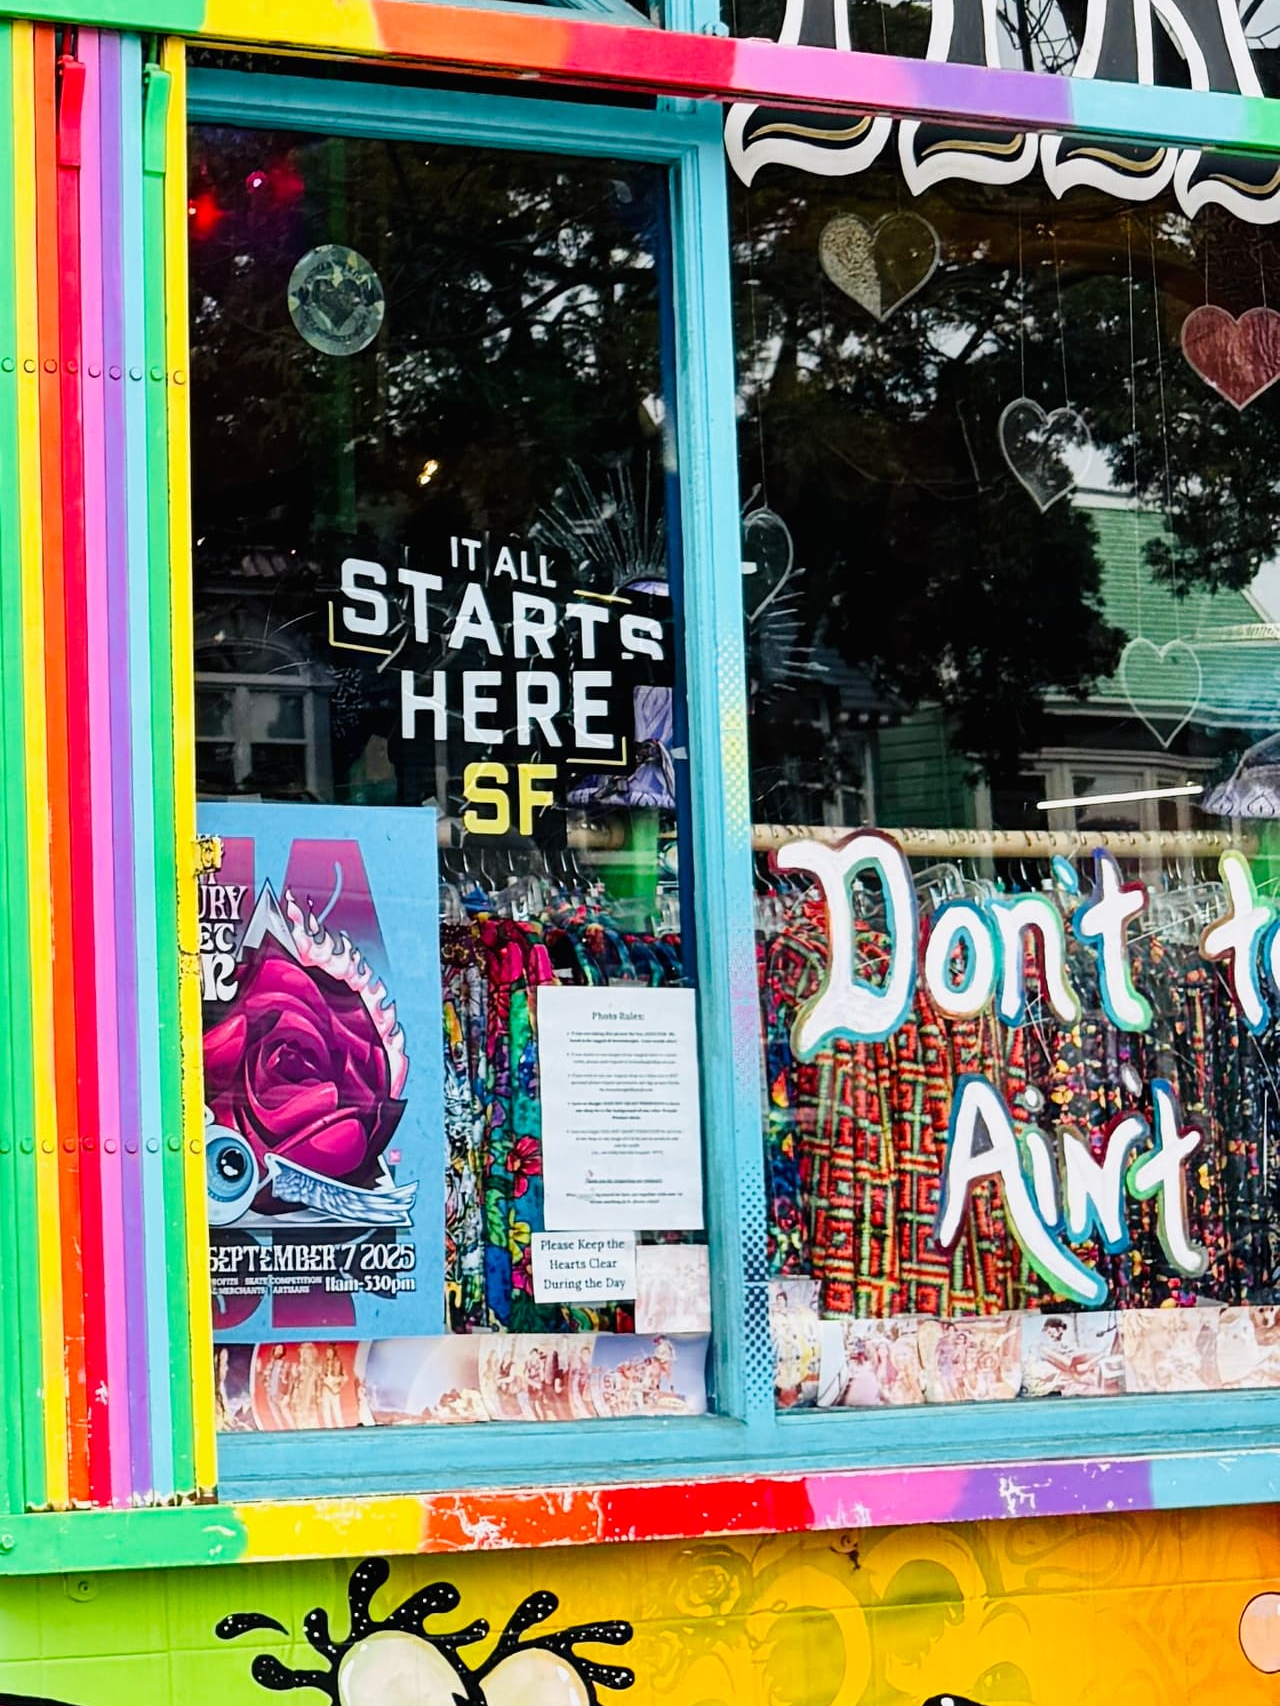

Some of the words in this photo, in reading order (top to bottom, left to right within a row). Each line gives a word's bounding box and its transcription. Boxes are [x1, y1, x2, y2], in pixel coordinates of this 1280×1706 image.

[450, 536, 481, 571] IT
[493, 546, 557, 588] ALL
[341, 557, 664, 661] STARTS
[401, 670, 614, 749] HERE
[463, 761, 558, 836] SF
[768, 829, 1153, 1062] Don't
[1200, 850, 1280, 1035] t
[209, 1244, 338, 1272] SEPTEMBER
[340, 1243, 357, 1271] 7
[360, 1242, 416, 1271] 2025
[540, 1240, 575, 1251] Please
[578, 1238, 605, 1252] Keep
[607, 1239, 625, 1249] the
[549, 1259, 586, 1270] Hearts
[589, 1258, 618, 1269] Clear
[543, 1278, 582, 1292] During
[585, 1278, 603, 1289] the
[606, 1277, 626, 1291] Day
